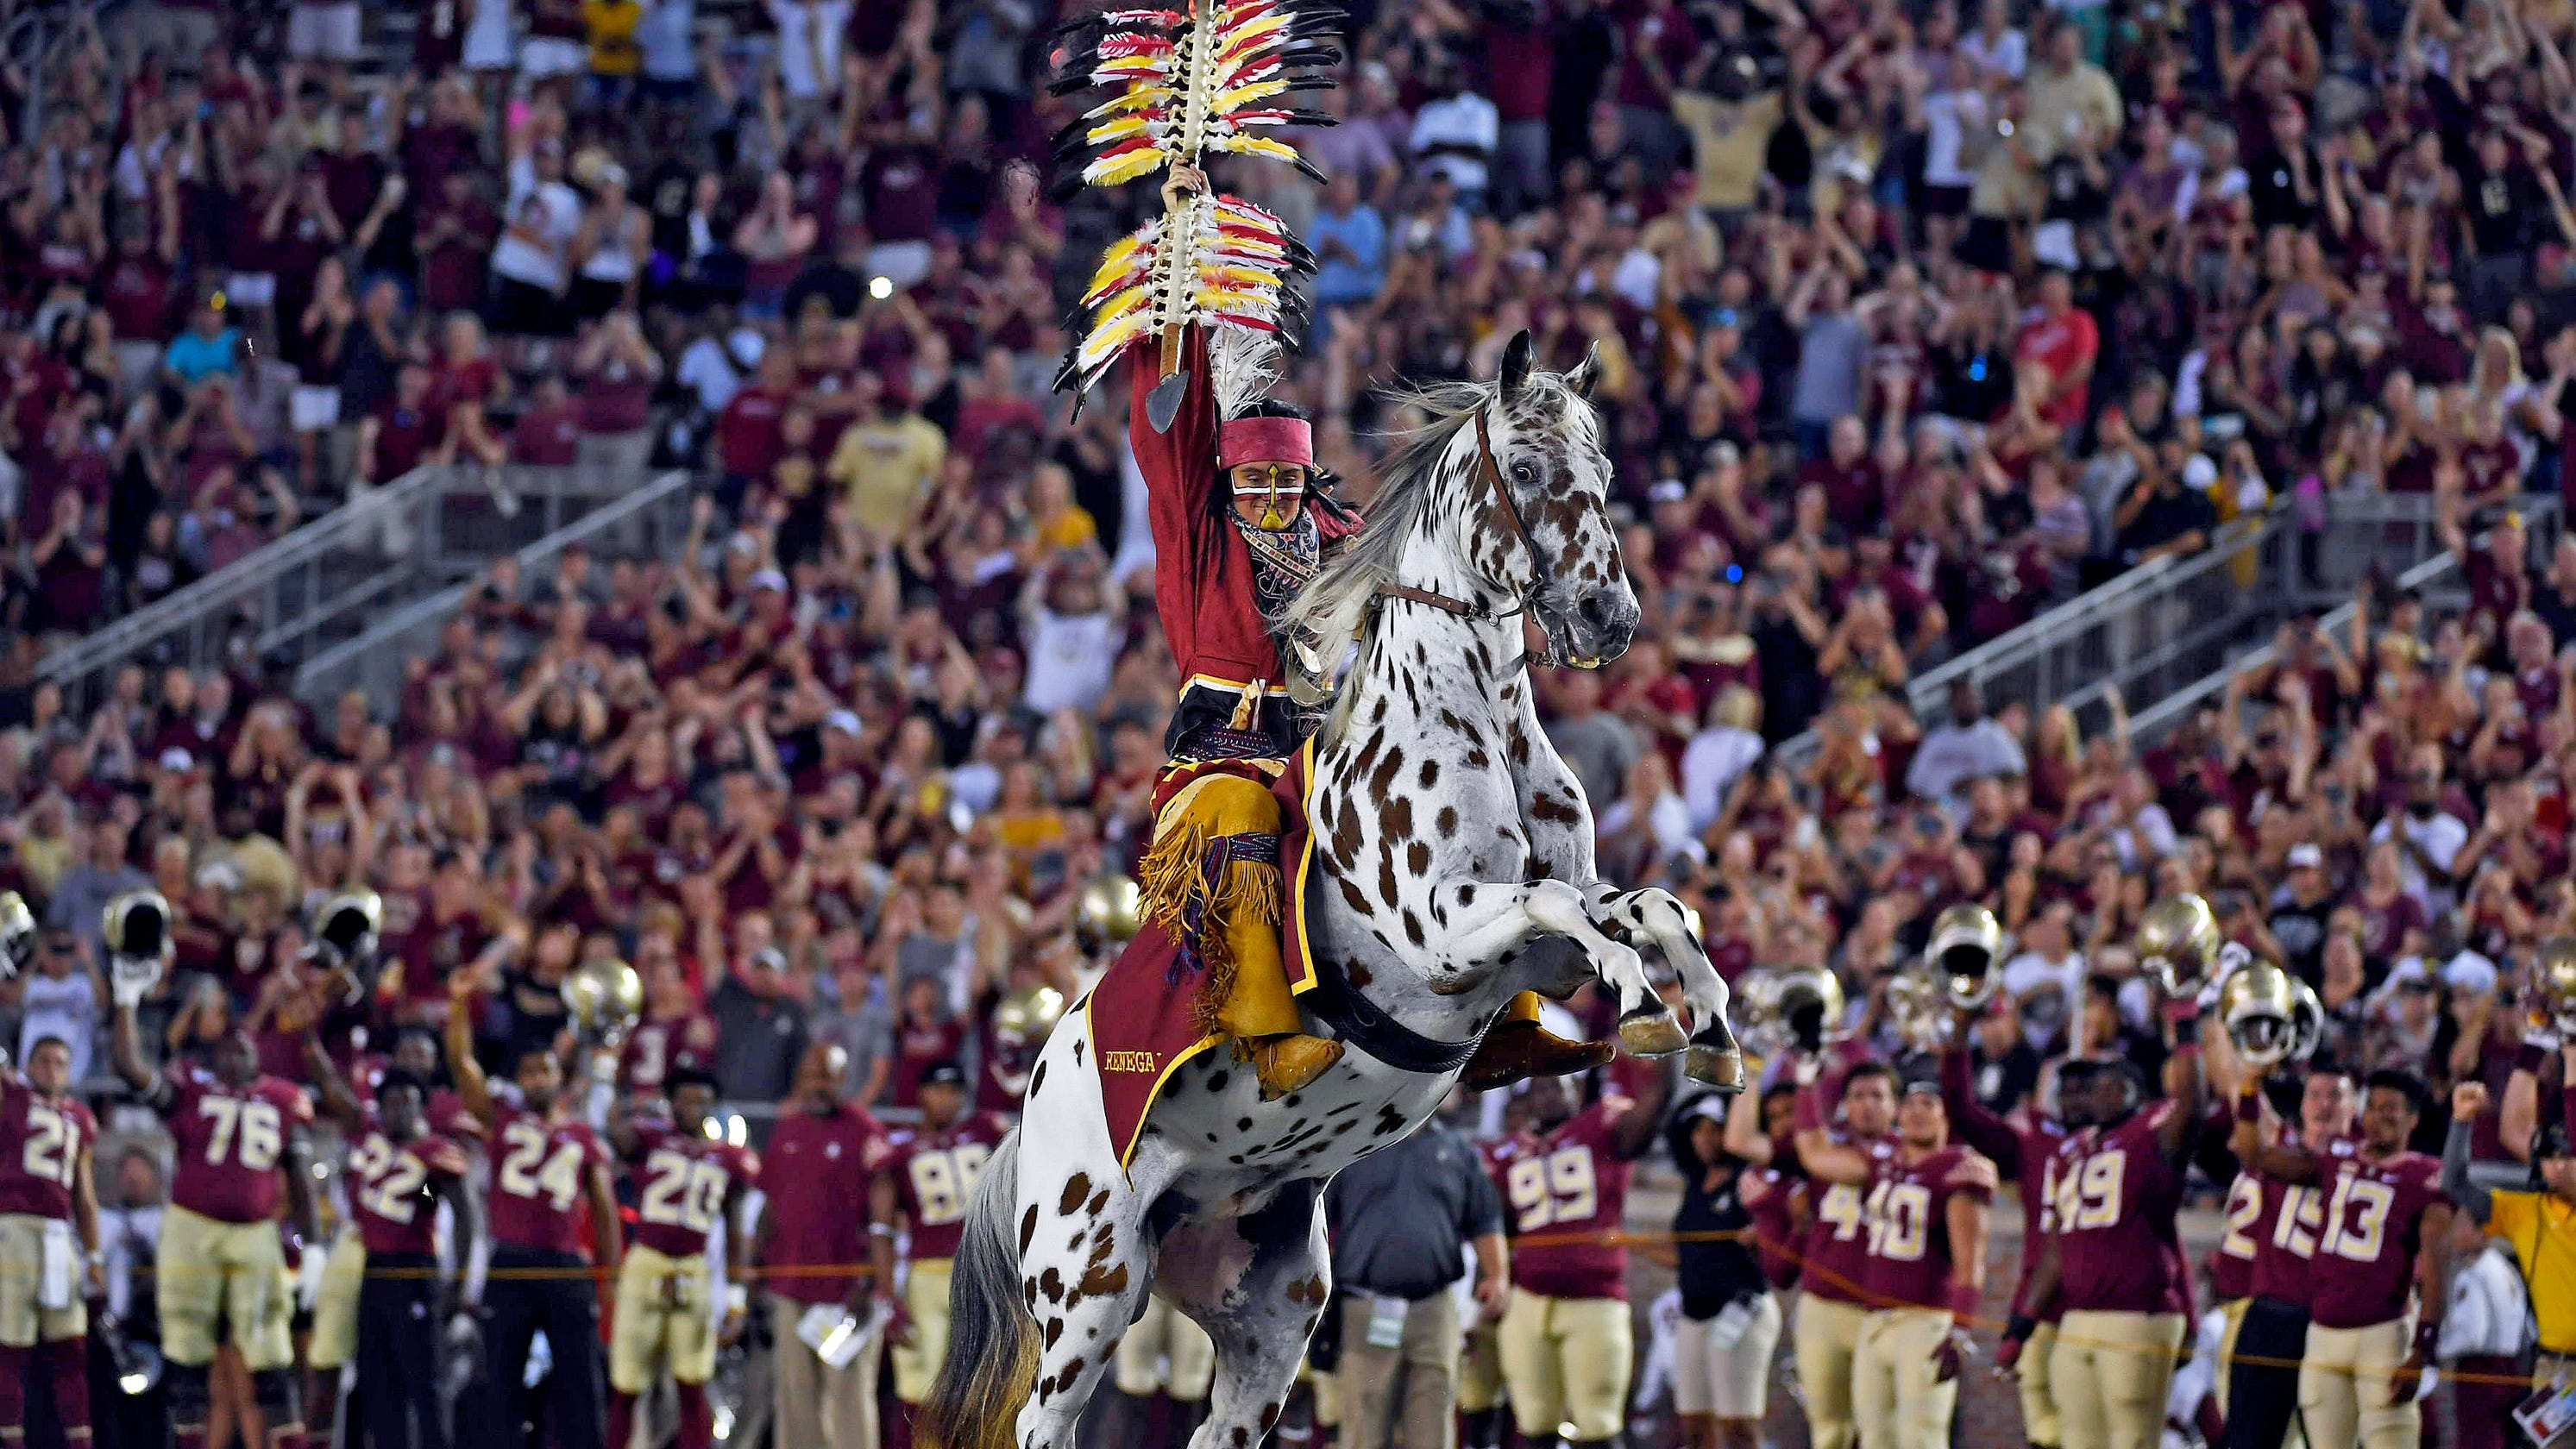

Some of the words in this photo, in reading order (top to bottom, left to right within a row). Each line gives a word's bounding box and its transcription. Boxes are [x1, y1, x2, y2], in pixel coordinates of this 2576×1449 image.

[23, 1104, 80, 1189] 21
[198, 1095, 282, 1171] 76
[502, 1124, 584, 1212] 24
[349, 1132, 427, 1225] 22
[641, 1149, 730, 1234] 20
[1507, 1144, 1596, 1233] 99
[1819, 1182, 1862, 1242] 4
[2321, 1172, 2396, 1263] 13
